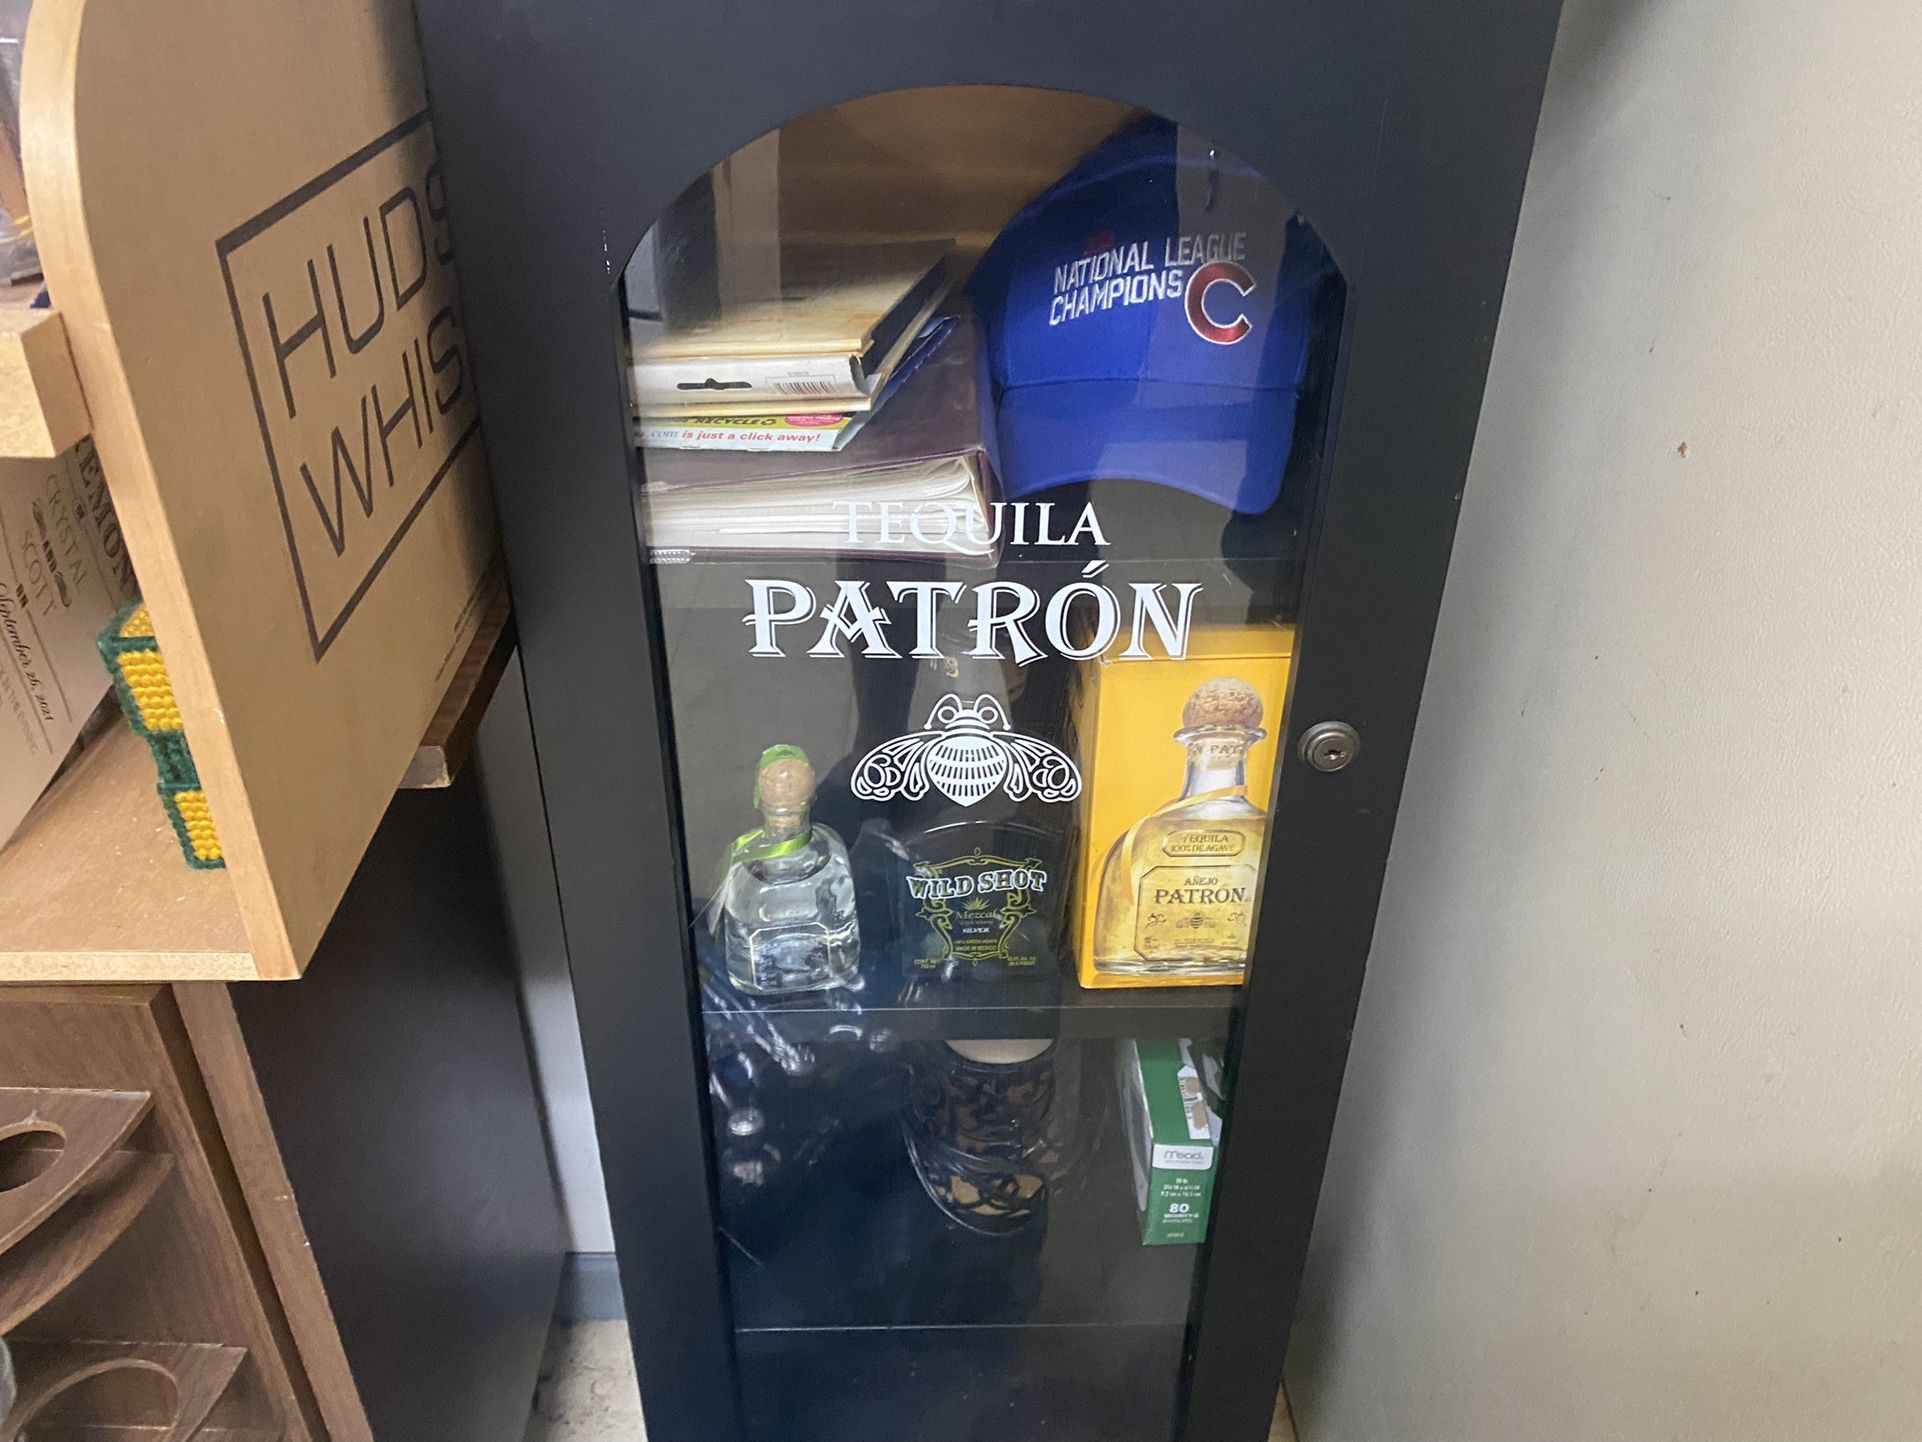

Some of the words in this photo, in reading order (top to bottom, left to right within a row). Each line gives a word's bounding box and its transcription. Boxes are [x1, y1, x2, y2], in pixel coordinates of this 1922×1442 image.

[1053, 241, 1154, 295] NATIONAL
[1164, 231, 1247, 267] LEAGUE
[1049, 269, 1183, 326] CHAMPIONS
[1184, 259, 1256, 346] C
[682, 430, 694, 439] is
[697, 431, 724, 441] just
[740, 432, 773, 441] click
[777, 432, 821, 443] away!
[46, 474, 88, 595] CRYSTAL
[832, 501, 1111, 556] TEQUILA
[21, 530, 57, 616] SCOTT
[741, 560, 1204, 667] PATRÓN
[1183, 834, 1229, 843] TEQUILA
[906, 876, 974, 900] WILD
[977, 869, 1048, 893] SHOT
[1184, 875, 1219, 886] AÑEJO
[1169, 1202, 1190, 1214] 80
